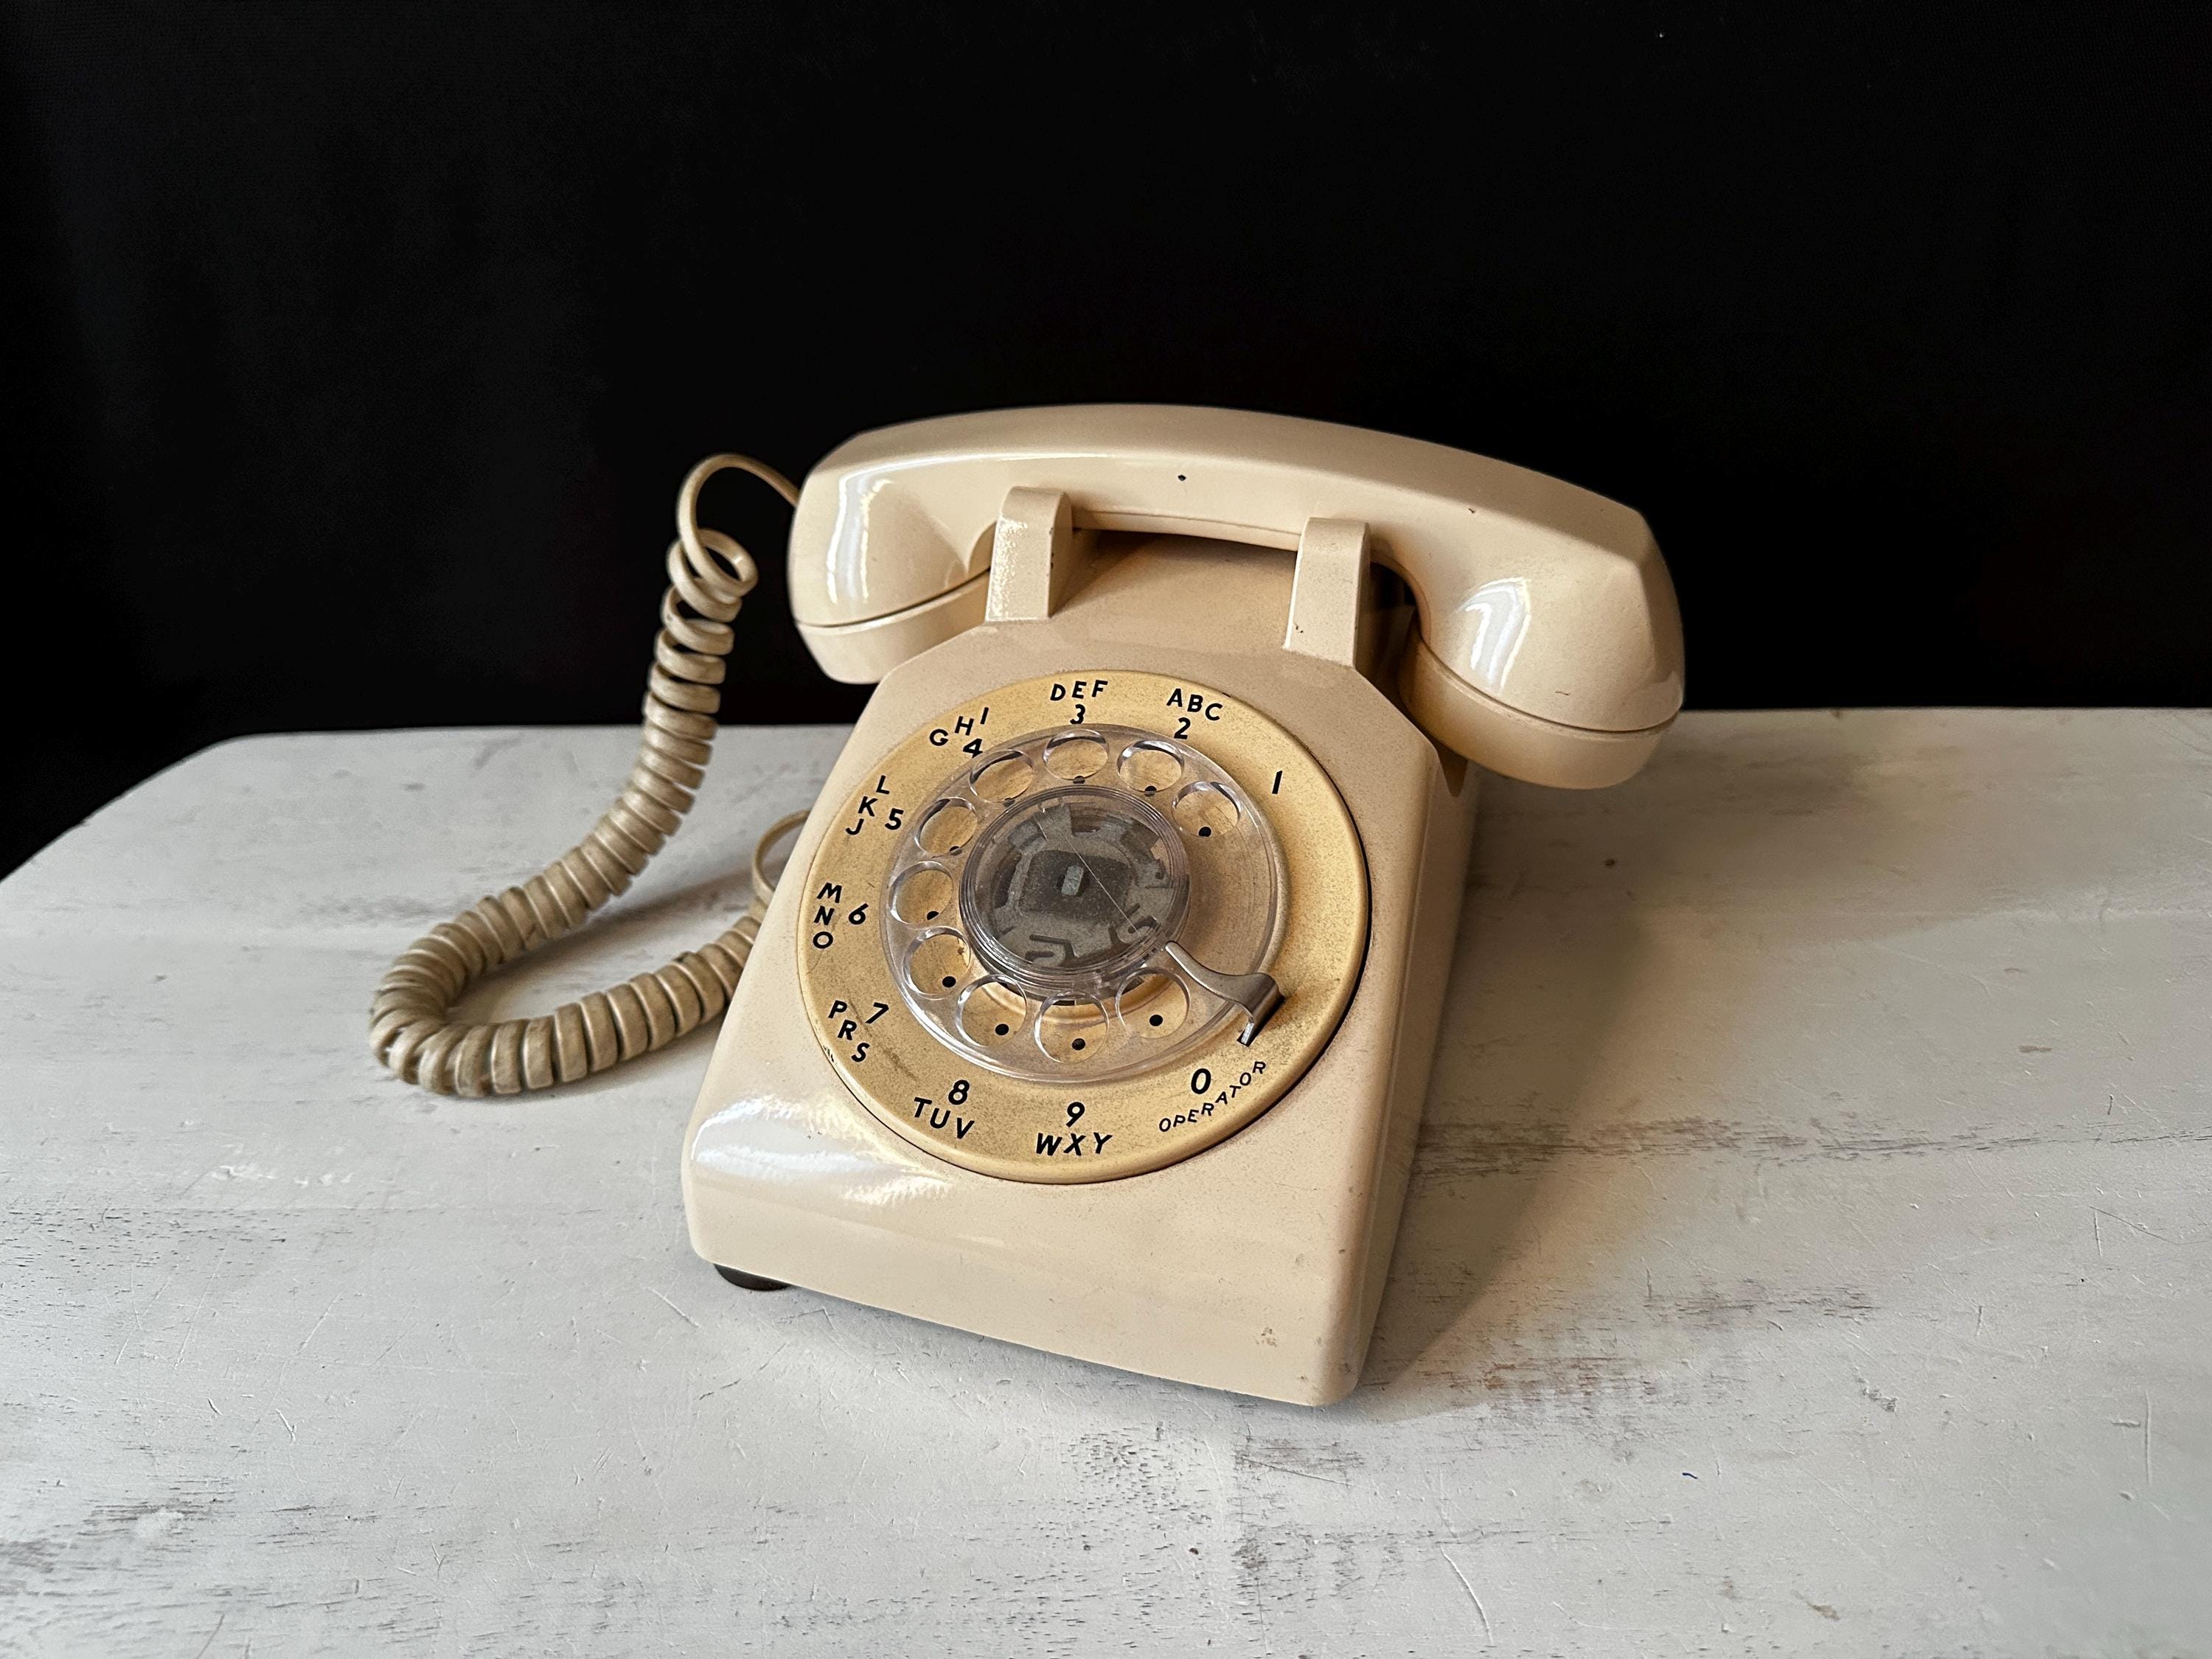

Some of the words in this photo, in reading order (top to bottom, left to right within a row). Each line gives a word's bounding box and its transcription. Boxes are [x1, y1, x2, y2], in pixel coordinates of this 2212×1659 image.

[1050, 679, 1108, 701] DEF
[1069, 703, 1086, 725] 3
[1166, 688, 1223, 721] ABC
[929, 706, 990, 746] GHI
[1173, 717, 1191, 740] 2
[962, 738, 984, 759] 4
[1271, 770, 1283, 795] 1
[884, 807, 904, 830] 5
[848, 902, 869, 925] 6
[865, 1002, 889, 1024] 7
[947, 1079, 970, 1105] 8
[1190, 1068, 1211, 1095] 0
[1158, 1061, 1267, 1133] OPERATOR
[914, 1096, 975, 1140] TUV
[1065, 1102, 1085, 1128] 9
[1036, 1132, 1113, 1157] WXY
